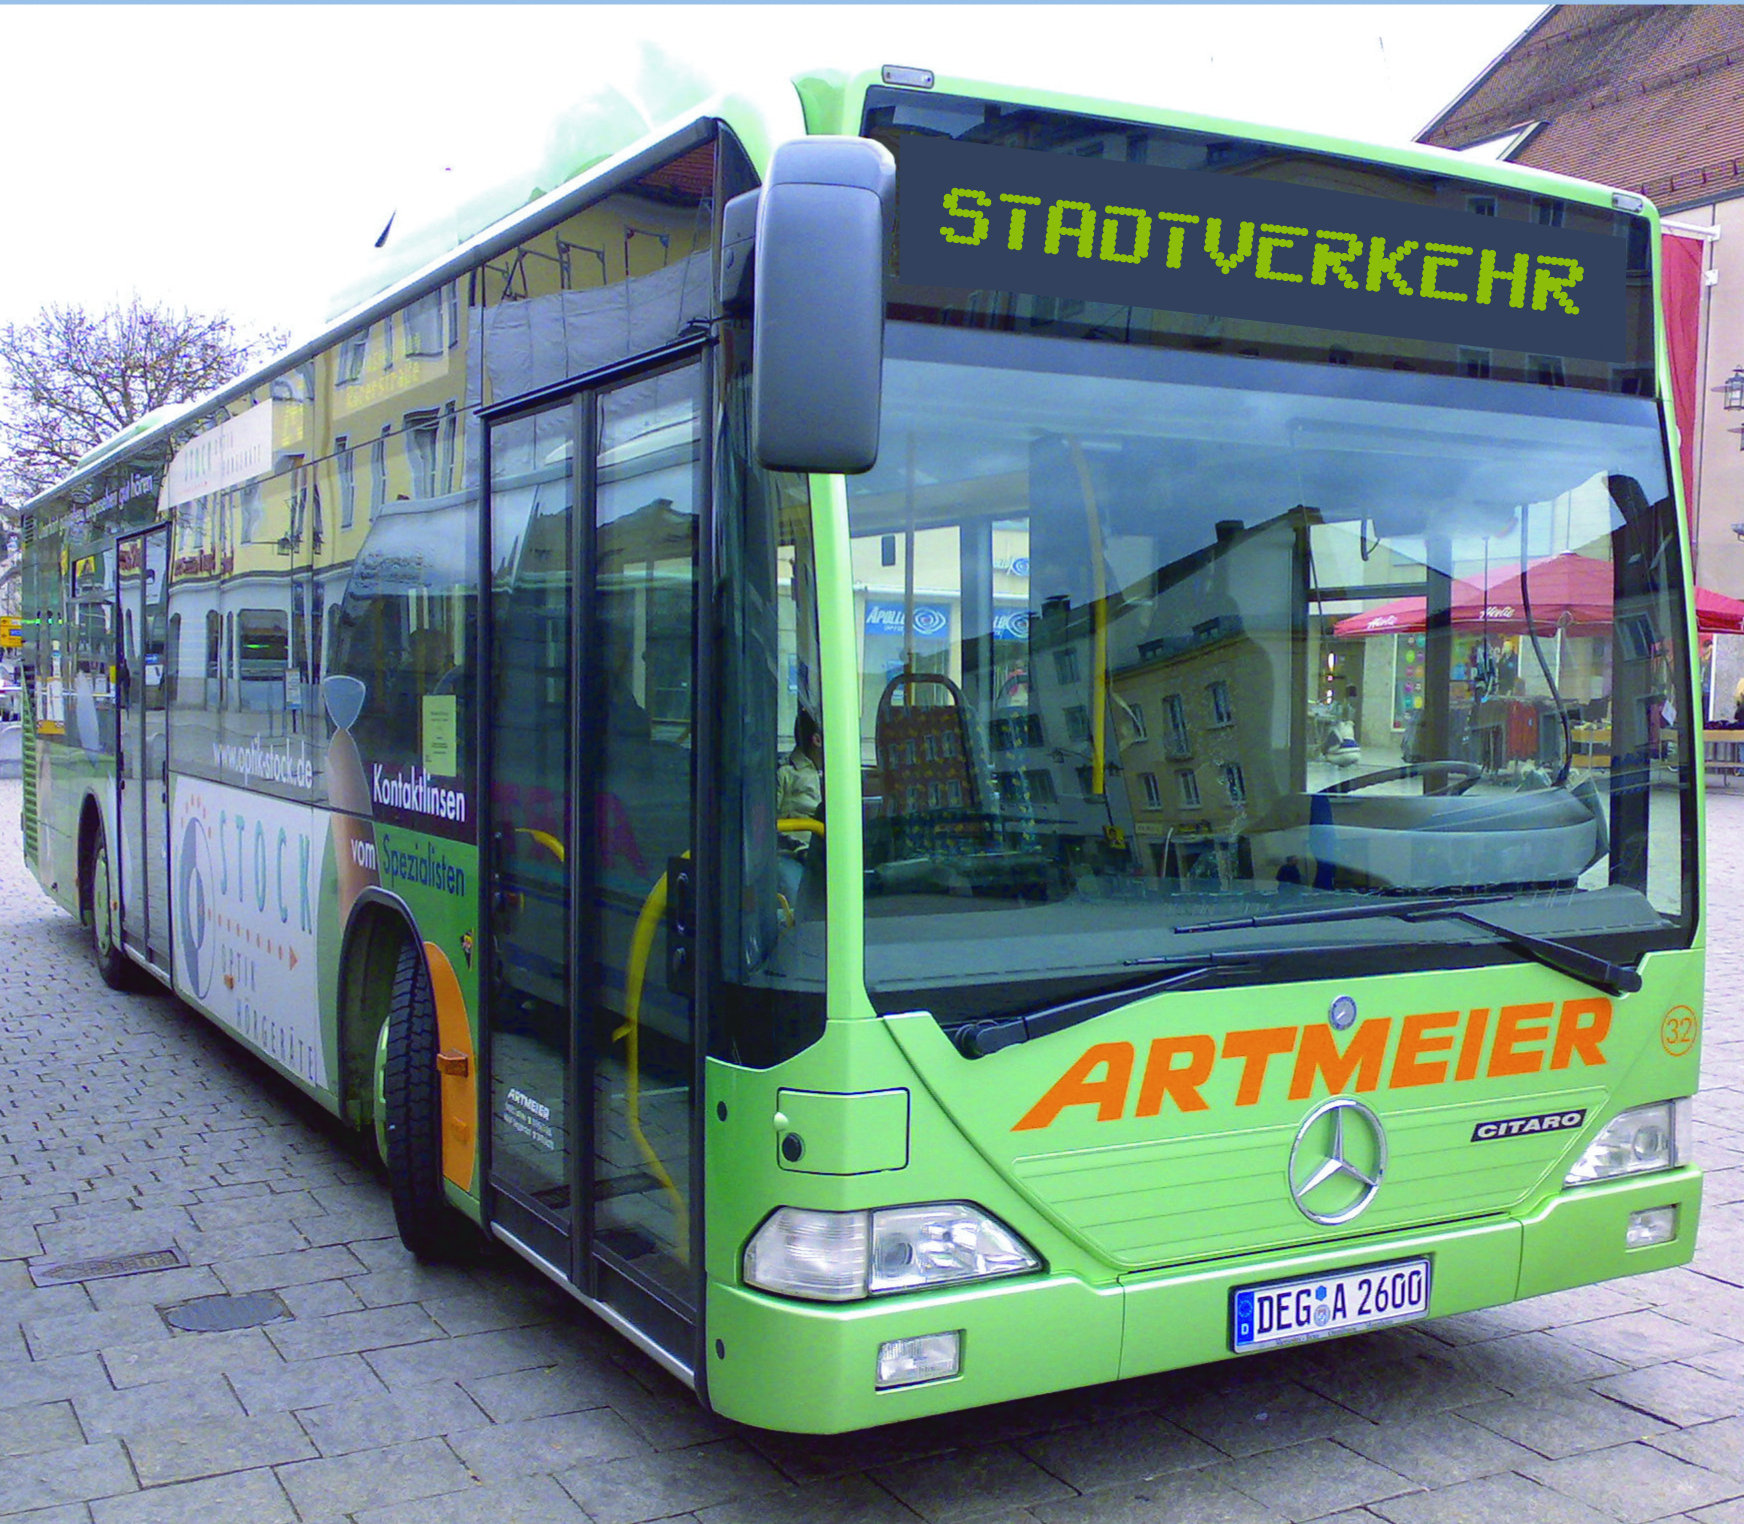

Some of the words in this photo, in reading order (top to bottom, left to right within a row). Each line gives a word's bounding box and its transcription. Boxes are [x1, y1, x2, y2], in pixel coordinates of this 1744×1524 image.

[939, 186, 1584, 316] STADTVERKEHR
[213, 733, 313, 790] www.optik-stock.de
[373, 763, 466, 823] Kontaktlinsen
[219, 809, 312, 935] STOCK
[351, 838, 377, 871] vom
[382, 833, 465, 898] Spezialisten
[1666, 1016, 1692, 1044] 32
[1010, 997, 1613, 1133] ARTMEIER
[1477, 1112, 1582, 1140] CITARO
[1240, 1323, 1250, 1335] D
[1256, 1288, 1311, 1334] DEG
[1332, 1282, 1347, 1322] A
[1357, 1269, 1422, 1316] 2600
